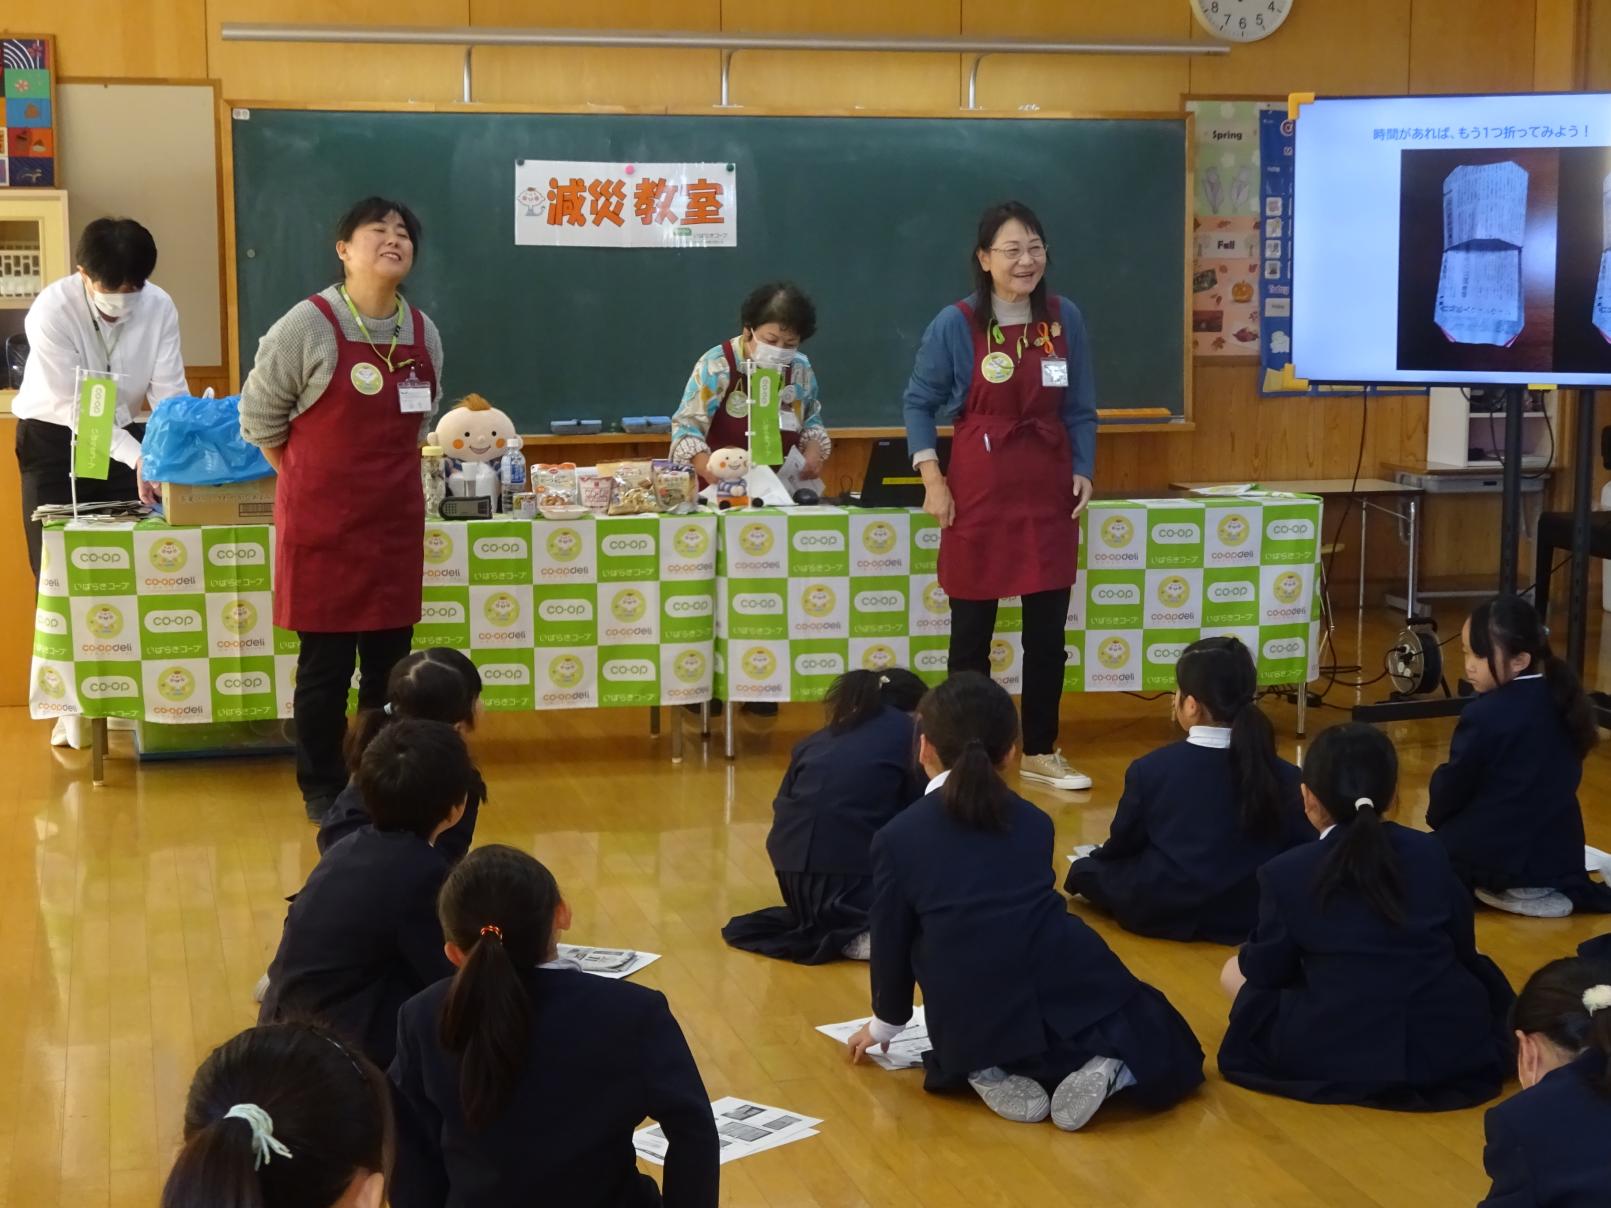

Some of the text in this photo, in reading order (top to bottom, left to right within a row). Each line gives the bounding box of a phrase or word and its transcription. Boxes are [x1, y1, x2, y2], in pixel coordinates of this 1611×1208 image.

[1211, 1, 1219, 13] 8
[1267, 1, 1275, 12] 4
[1224, 14, 1231, 25] 7
[1239, 18, 1247, 29] 6
[1256, 14, 1263, 25] 5
[1212, 130, 1243, 141] Spring
[546, 177, 725, 227] 減災教室
[1217, 240, 1236, 250] Fall
[473, 571, 527, 580] いばらきコープ
[602, 568, 655, 577] いばらきコープ
[73, 582, 130, 592] いばらきコープ
[539, 633, 592, 642] いばらきコープ
